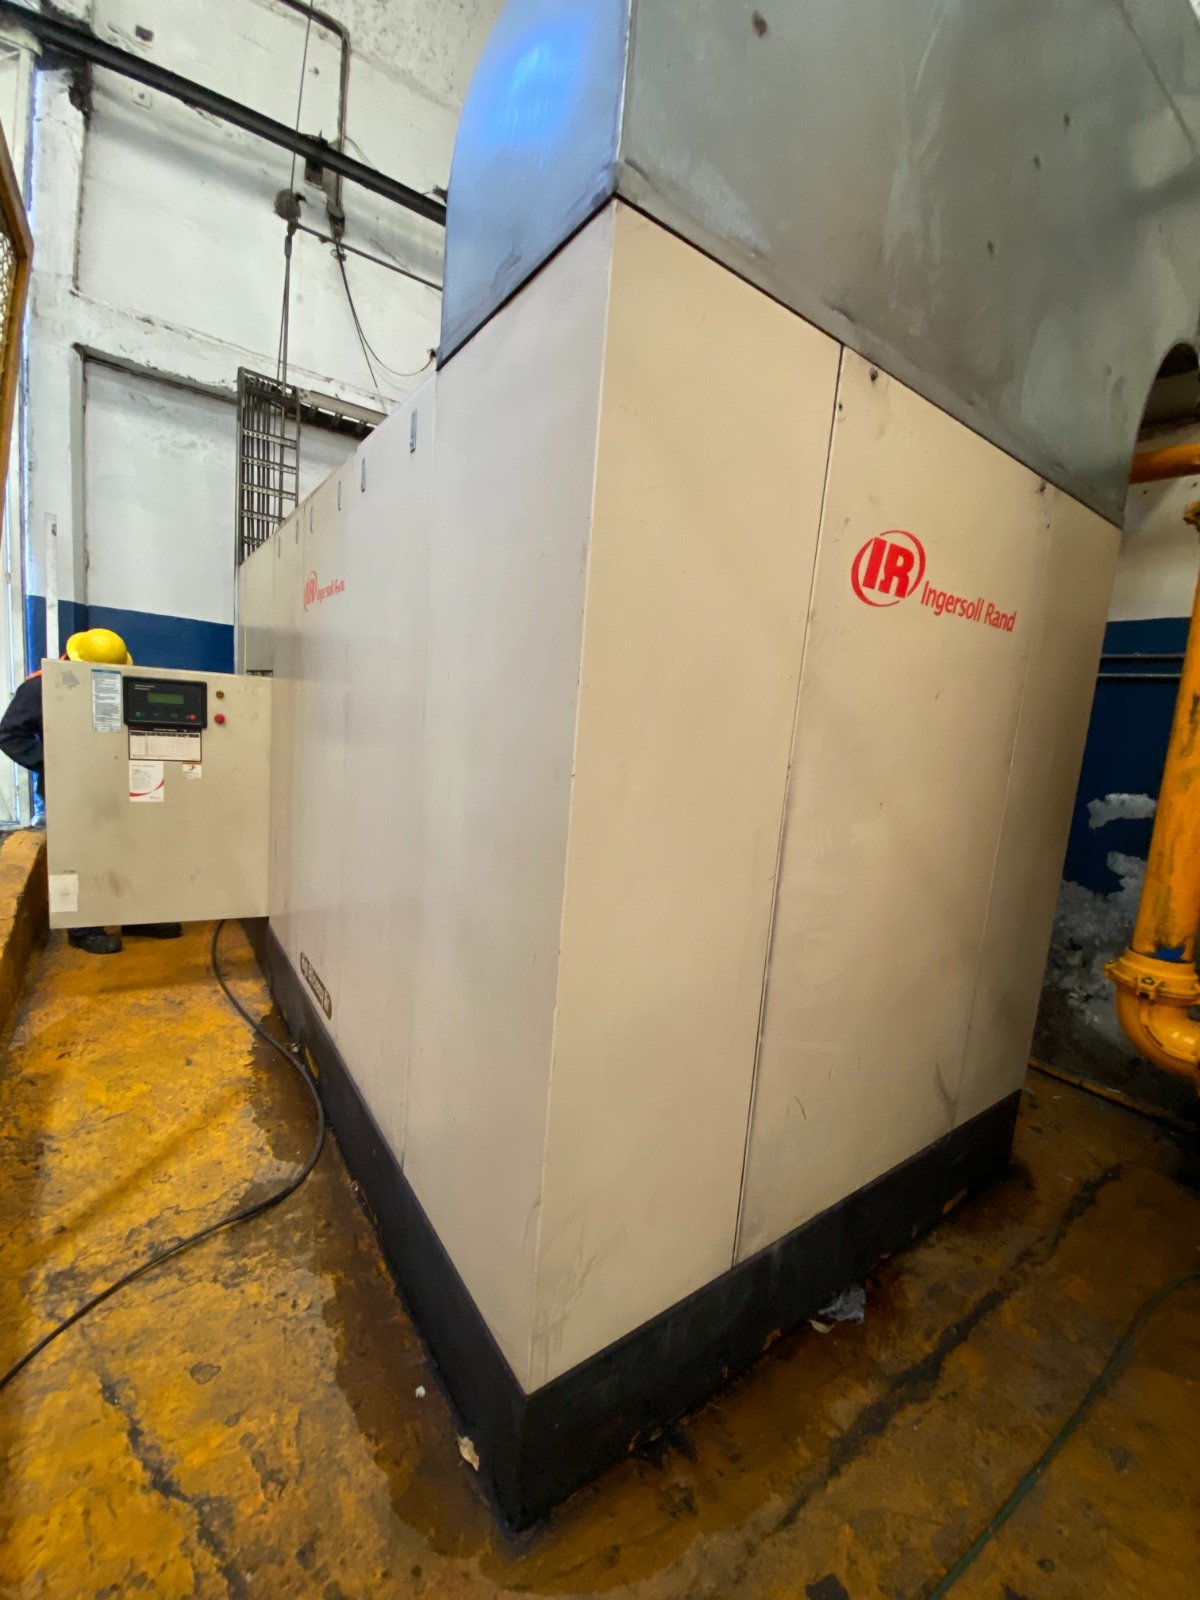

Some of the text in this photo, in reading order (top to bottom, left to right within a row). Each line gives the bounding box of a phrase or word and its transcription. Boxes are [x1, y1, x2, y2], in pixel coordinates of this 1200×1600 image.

[862, 536, 915, 599] IR
[920, 580, 1017, 632] Ingersoll Rand
